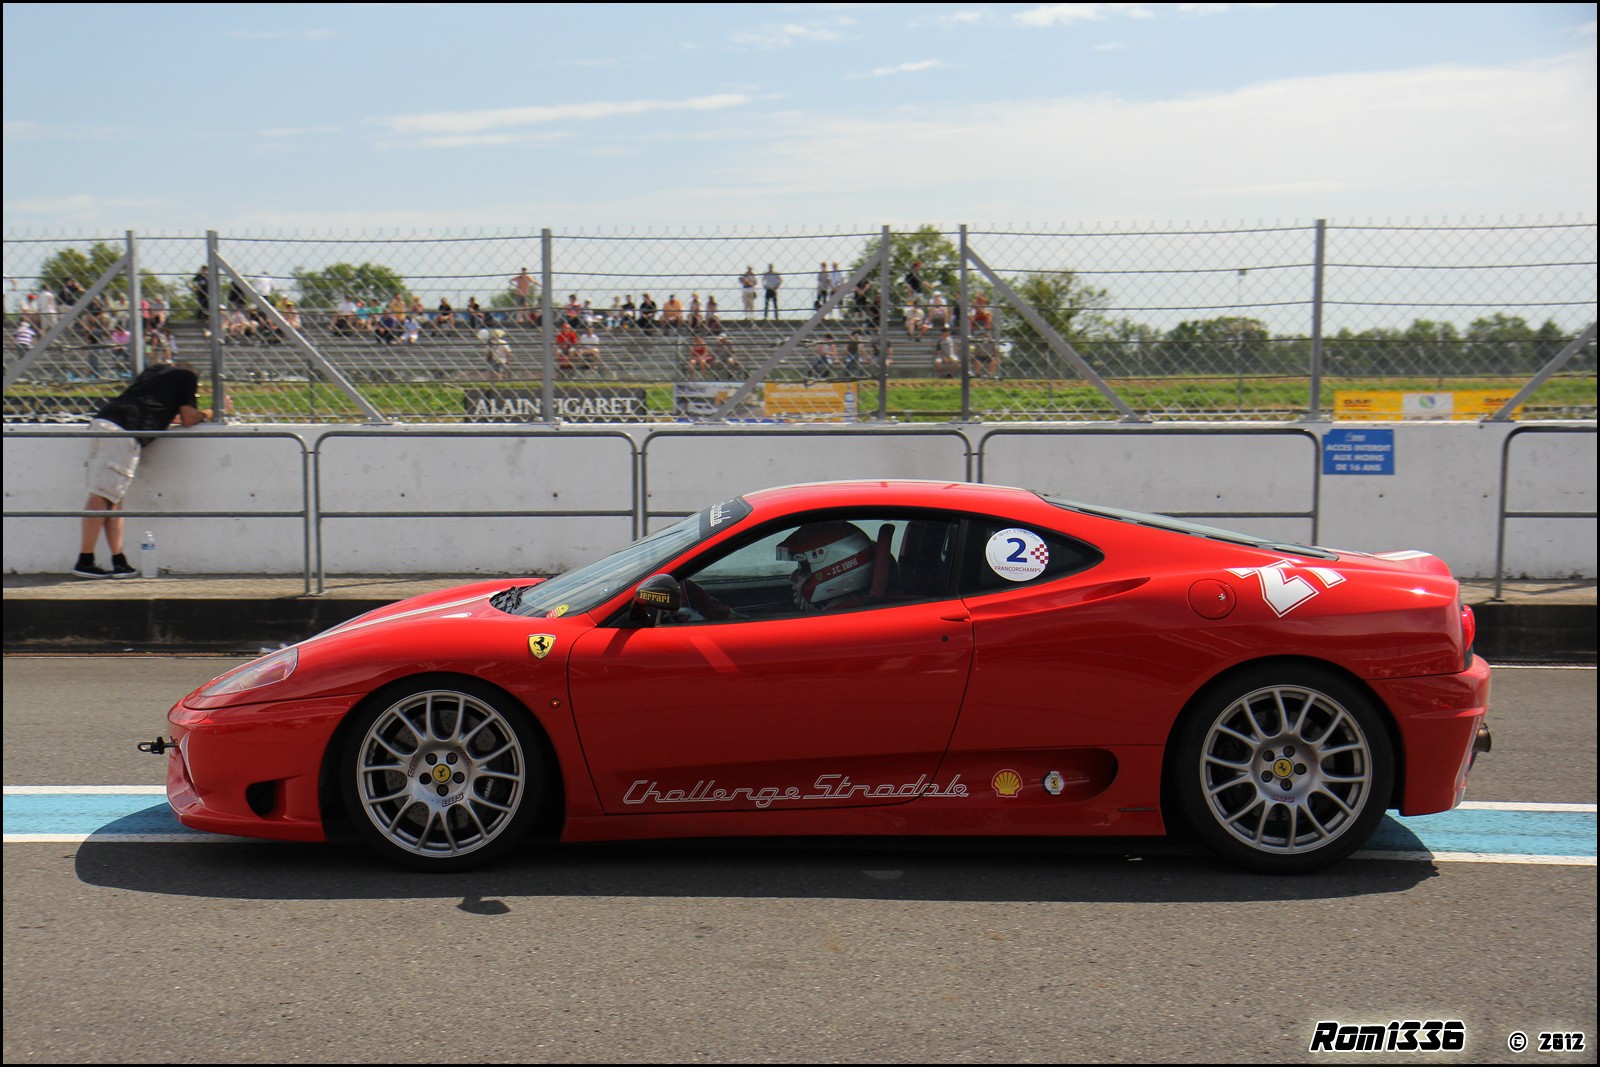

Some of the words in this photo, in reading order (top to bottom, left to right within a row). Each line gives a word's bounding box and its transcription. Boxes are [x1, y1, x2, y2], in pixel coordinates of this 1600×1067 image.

[474, 398, 542, 415] ALAIN
[1354, 454, 1385, 462] MOINS
[1006, 537, 1028, 563] 2
[994, 565, 1041, 573] FRANCORCHAMPS
[639, 589, 670, 604] Ferrari
[622, 779, 801, 808] Challenge
[802, 773, 969, 800] Stradale
[441, 792, 464, 808] BBS
